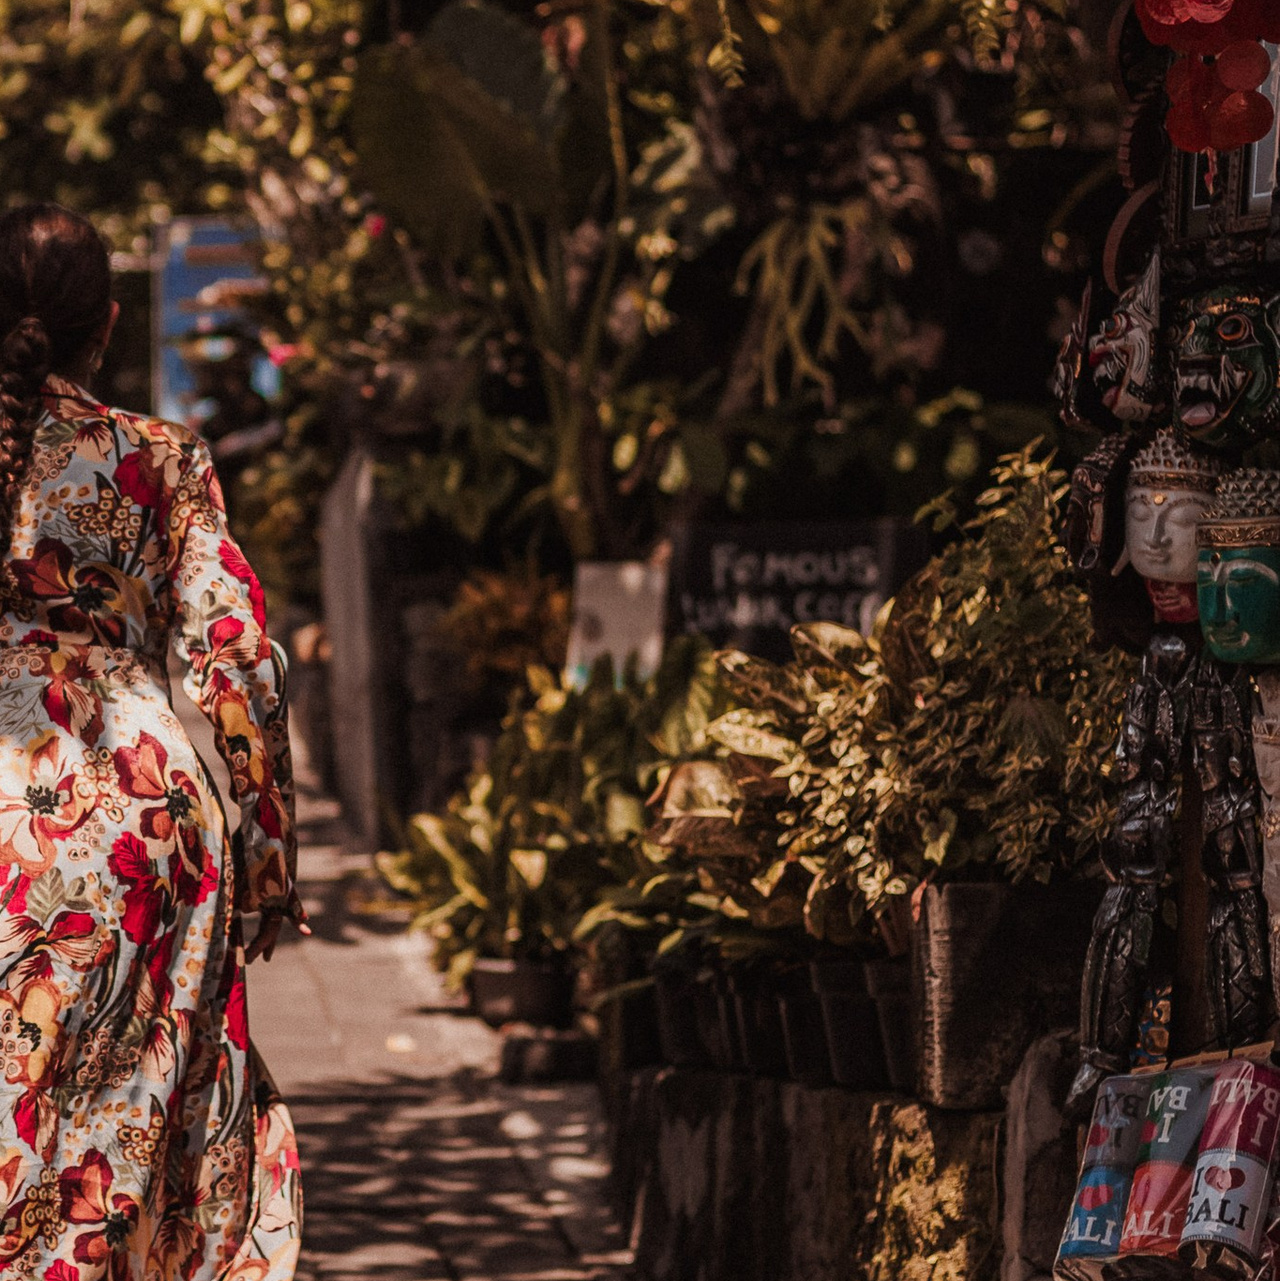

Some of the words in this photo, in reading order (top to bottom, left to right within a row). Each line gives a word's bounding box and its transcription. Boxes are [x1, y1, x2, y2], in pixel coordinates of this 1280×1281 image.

[1145, 1084, 1192, 1118] BA
[1063, 1215, 1117, 1247] ALI
[1121, 1209, 1176, 1239] ALI
